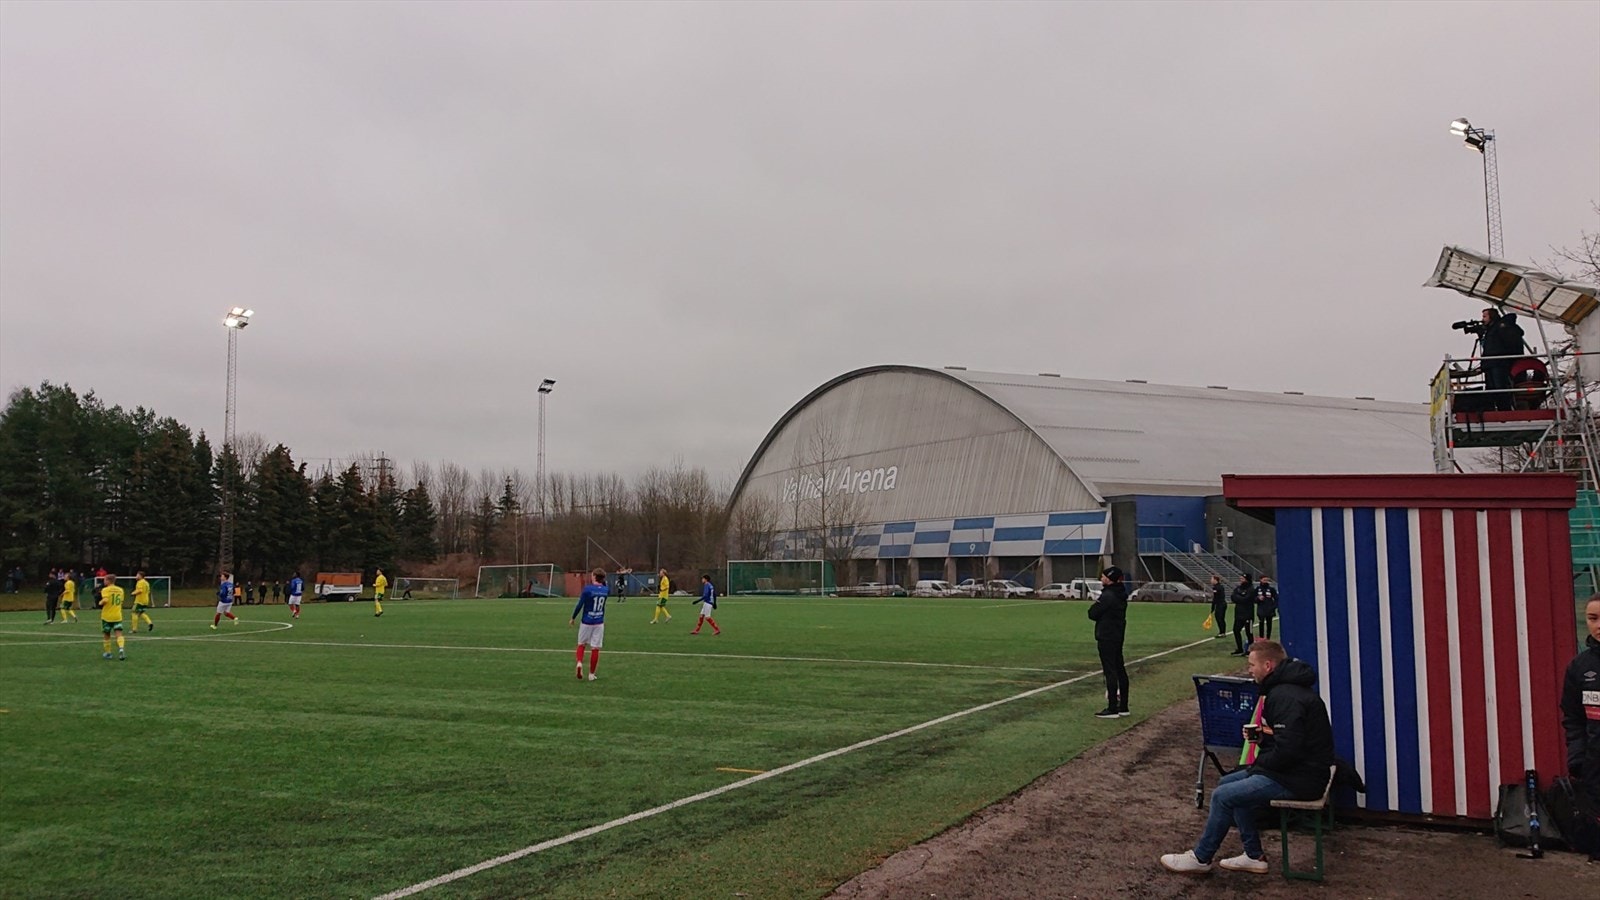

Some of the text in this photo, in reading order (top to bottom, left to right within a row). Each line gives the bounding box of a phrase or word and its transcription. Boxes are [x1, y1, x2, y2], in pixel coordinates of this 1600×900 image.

[836, 465, 898, 495] Arena
[969, 543, 976, 554] 9
[112, 593, 121, 606] 16
[593, 596, 605, 612] 18
